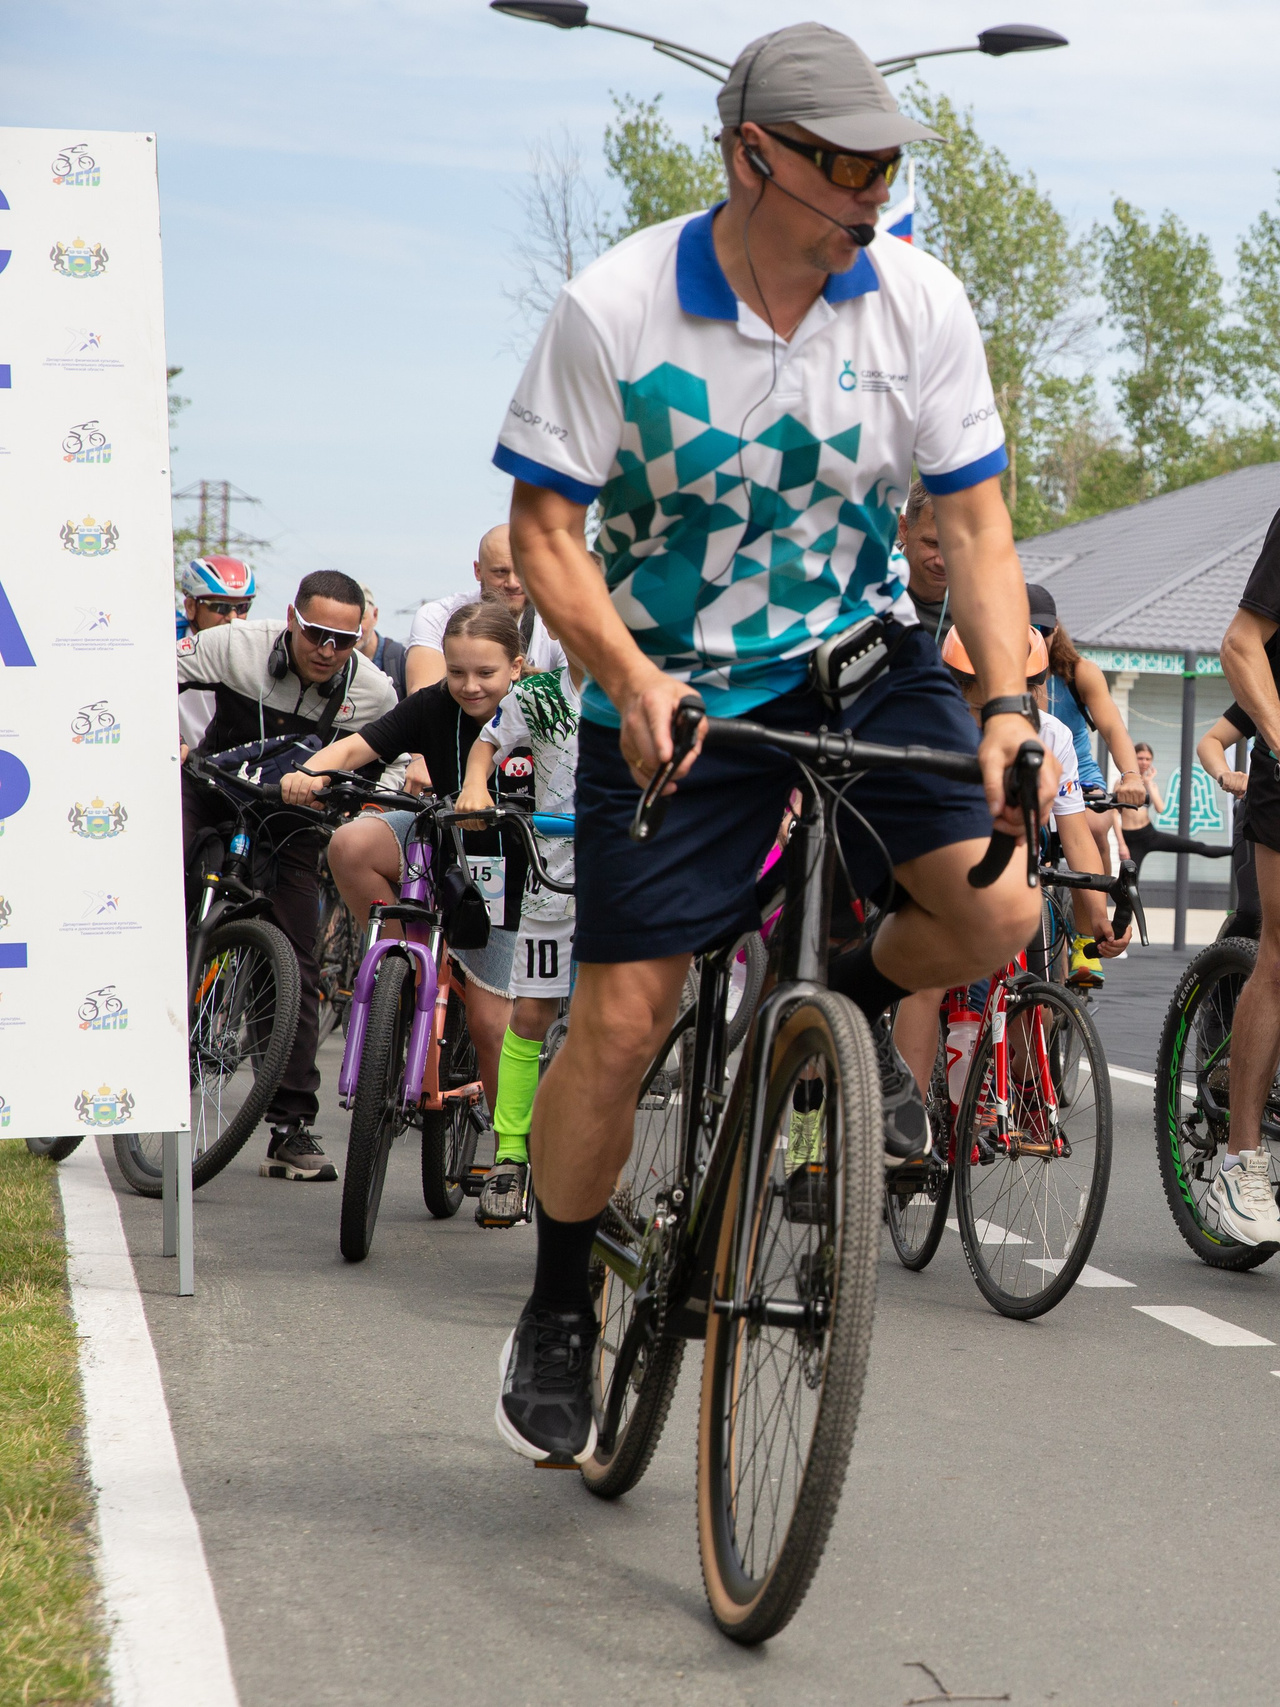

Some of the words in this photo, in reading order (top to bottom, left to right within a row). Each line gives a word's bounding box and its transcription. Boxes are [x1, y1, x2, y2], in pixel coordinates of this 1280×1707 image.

[470, 867, 492, 882] 15
[525, 938, 559, 979] 10
[1177, 972, 1200, 1009] KENDA
